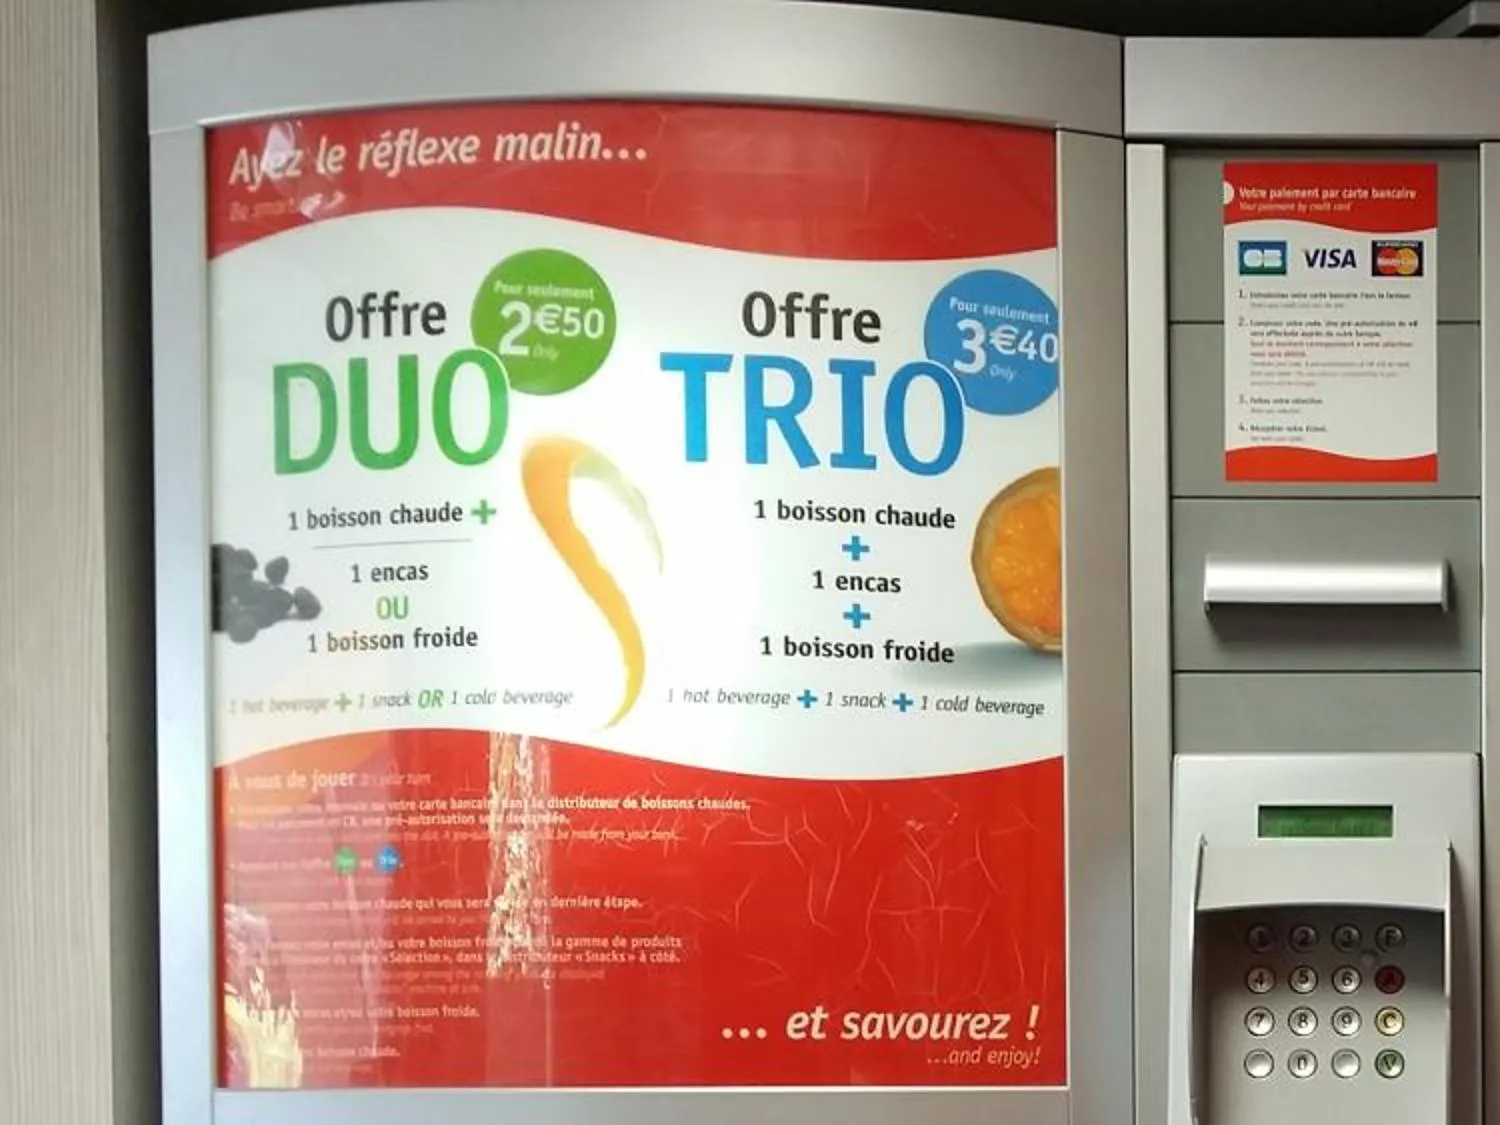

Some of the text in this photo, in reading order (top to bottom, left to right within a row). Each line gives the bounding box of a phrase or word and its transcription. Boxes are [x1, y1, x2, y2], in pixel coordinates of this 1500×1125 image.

[316, 136, 346, 174] le
[358, 128, 480, 178] réflexe
[493, 121, 648, 162] malin...
[1240, 187, 1416, 200] Votre paiement par carte bancaire
[1304, 248, 1357, 269] VISA
[494, 281, 595, 300] Pour seulement
[325, 291, 447, 341] Offre
[742, 290, 881, 344] Offre
[949, 296, 1050, 324] Pour seulement
[498, 300, 605, 357] 2€50
[953, 319, 1058, 374] 3€40
[273, 348, 509, 475] DUO
[660, 351, 965, 477] TRIO
[289, 503, 463, 531] 1 boisson chaude
[755, 499, 956, 530] 1 boisson chaude
[351, 563, 429, 583] 1 encas
[812, 570, 901, 594] 1 encas
[377, 596, 409, 620] OU
[308, 628, 479, 653] 1 boisson froide
[760, 636, 955, 663] 1 boisson froide
[372, 691, 411, 709] snack
[417, 690, 445, 709] OR
[465, 689, 495, 706] cold
[502, 688, 573, 707] beverage
[682, 688, 1045, 717] hot beverage 1 snack 1 cold beverage
[312, 771, 355, 793] jouer
[547, 797, 619, 810] distributeur
[642, 797, 695, 810] boissons
[566, 937, 609, 950] gamme
[611, 935, 627, 948] de
[631, 935, 683, 950] produits
[786, 1005, 1011, 1040] et savourez
[987, 1046, 1041, 1068] enjoy!
